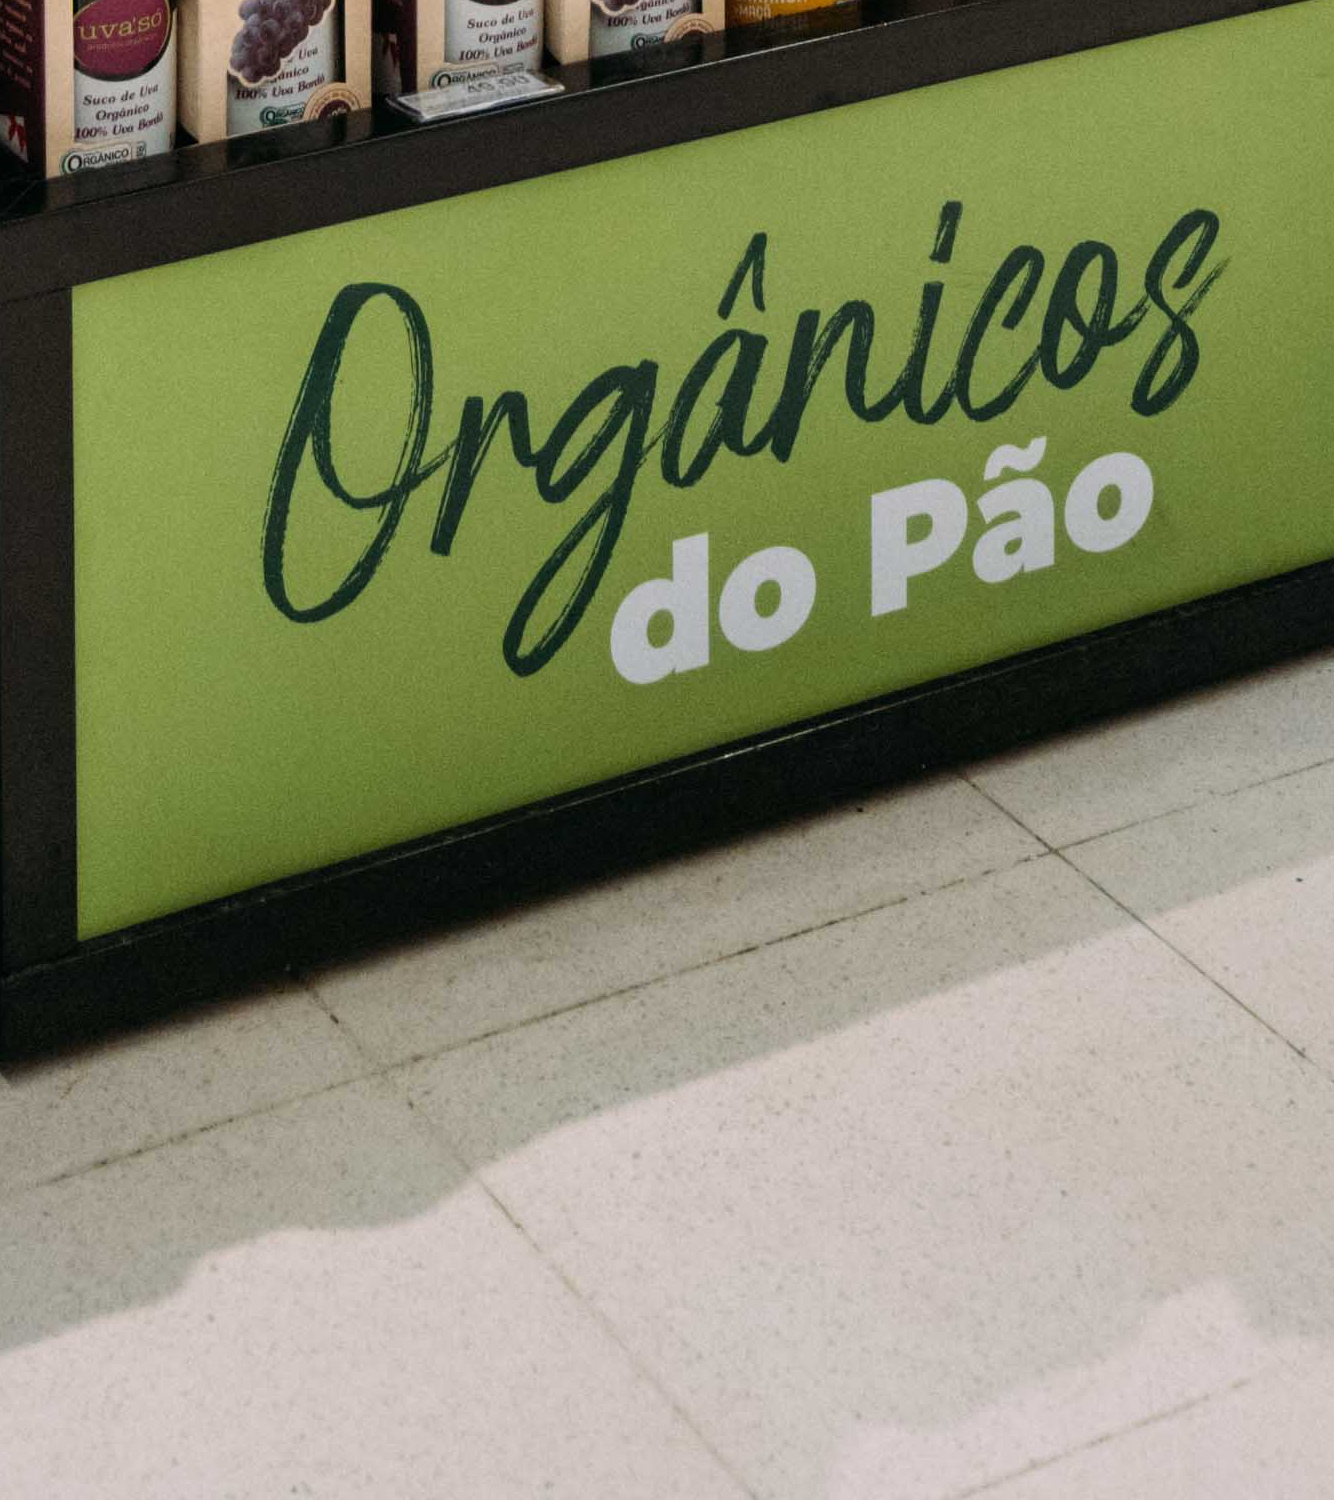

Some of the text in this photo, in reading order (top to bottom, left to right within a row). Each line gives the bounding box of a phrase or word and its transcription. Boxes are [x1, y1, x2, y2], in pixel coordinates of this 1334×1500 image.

[467, 8, 535, 30] Suco de Uva
[607, 14, 638, 28] 100%
[642, 12, 662, 26] Uva
[478, 26, 527, 45] Orgânico
[298, 46, 319, 61] Uva
[459, 47, 490, 62] 100%
[493, 44, 514, 58] Uva
[83, 82, 159, 106] Suco de Uva
[234, 87, 268, 101] 100%
[271, 84, 295, 98] Uva
[95, 103, 150, 124] Orgânico
[74, 123, 109, 139] 100%
[112, 121, 135, 136] Uva
[261, 200, 1231, 678] Orgânicos
[610, 435, 1156, 685] do Pão
